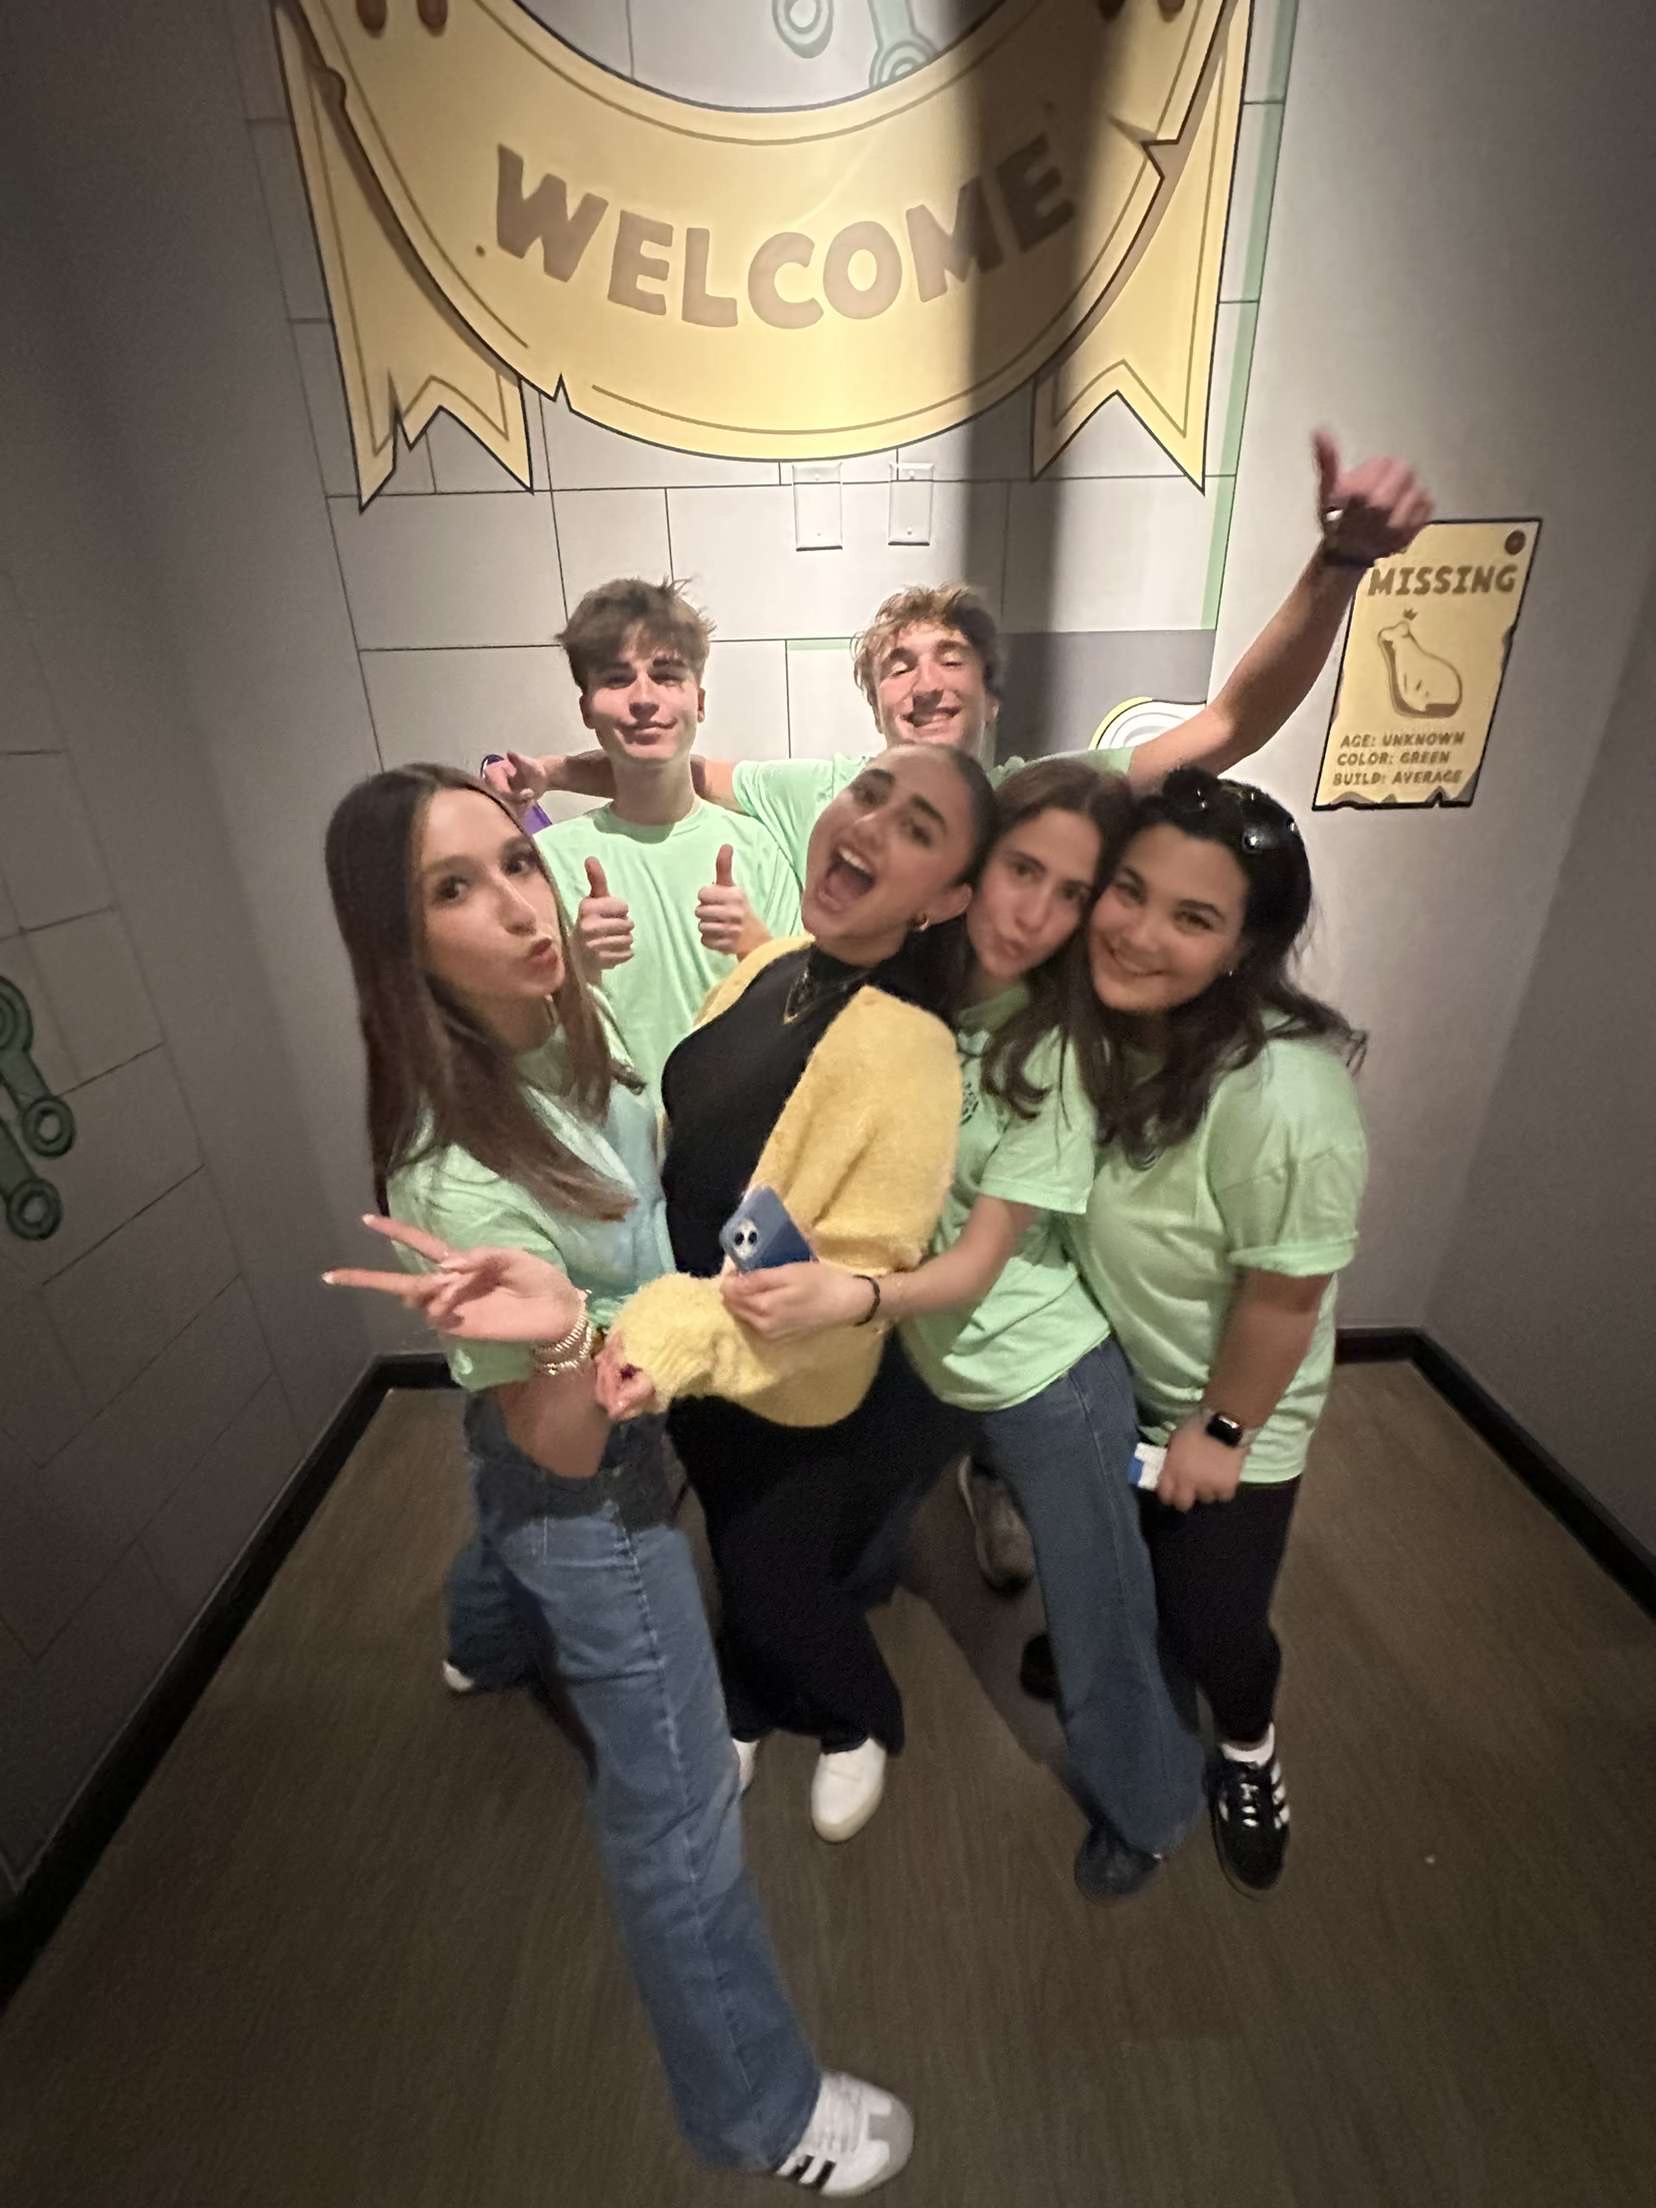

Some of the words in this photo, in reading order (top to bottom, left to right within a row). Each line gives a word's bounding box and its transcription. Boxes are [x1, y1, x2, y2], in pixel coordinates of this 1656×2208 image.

[496, 132, 1077, 328] WELCOME
[1367, 564, 1519, 597] MISSING
[1341, 734, 1376, 748] AGE:
[1382, 731, 1465, 746] UNKNOWN
[1336, 752, 1393, 766] COLOR:
[1399, 751, 1450, 765] GREEN
[1332, 772, 1386, 786] BUILD:
[1393, 770, 1462, 784] AVERAGE
